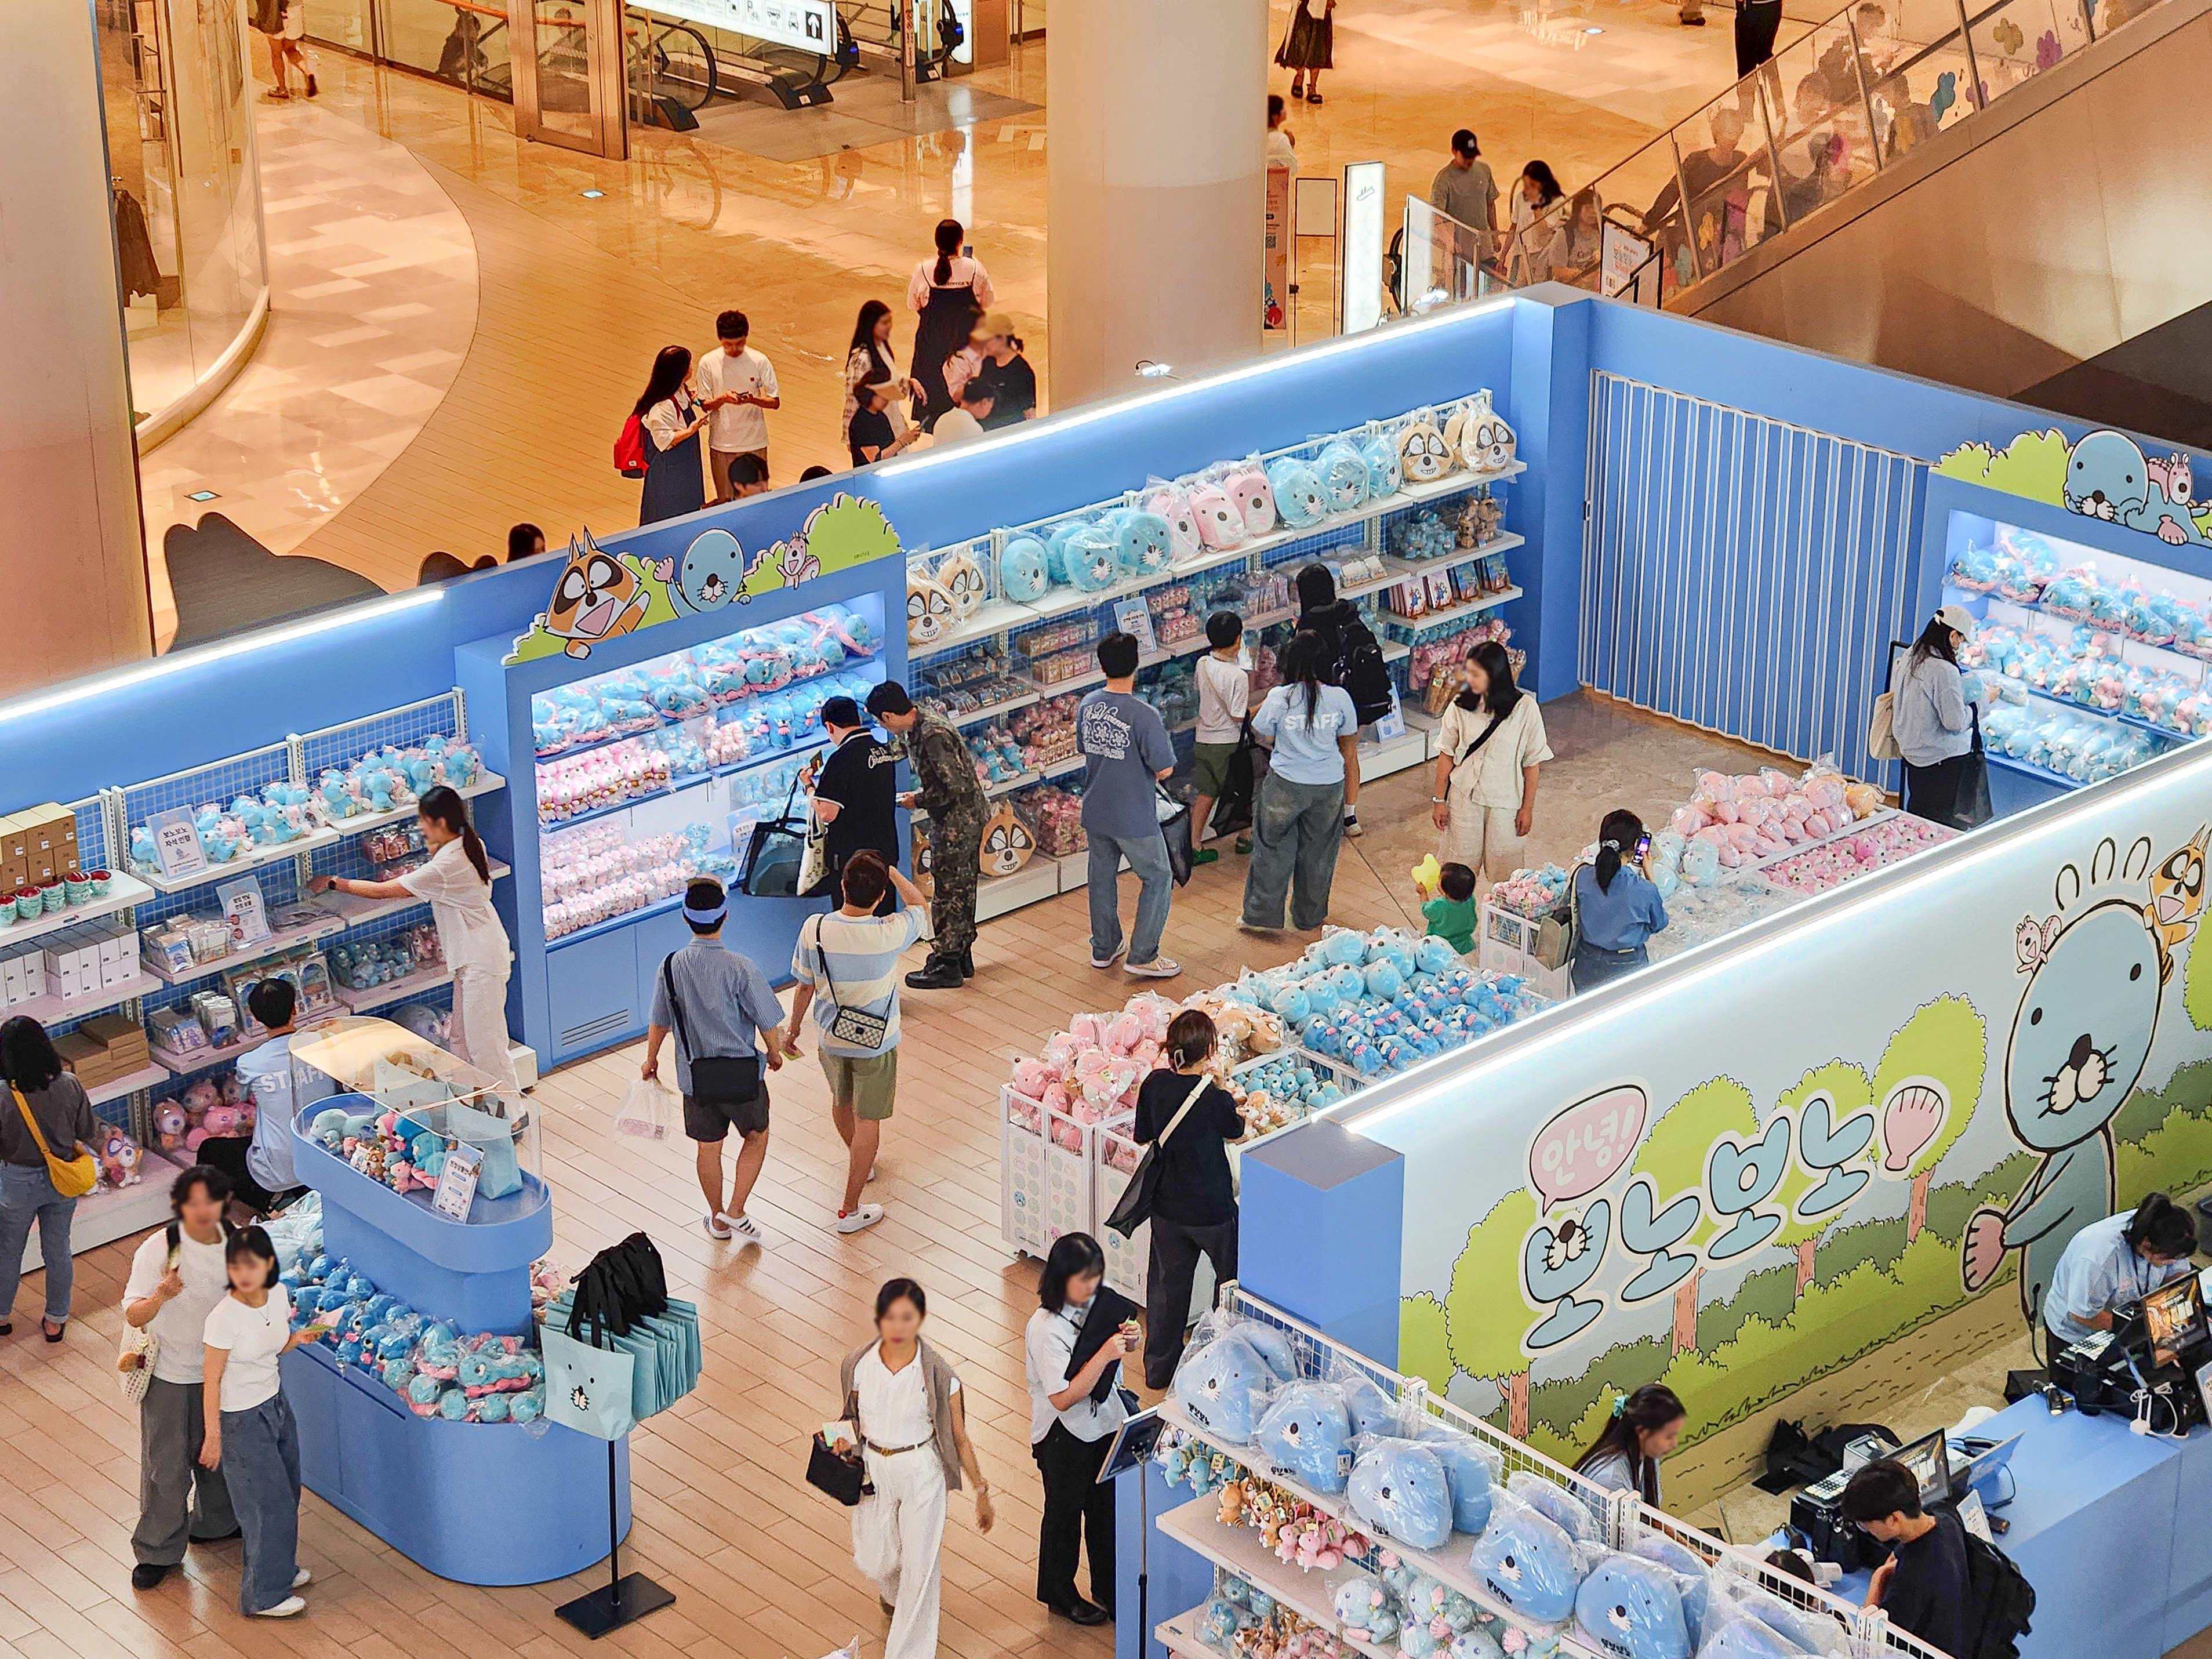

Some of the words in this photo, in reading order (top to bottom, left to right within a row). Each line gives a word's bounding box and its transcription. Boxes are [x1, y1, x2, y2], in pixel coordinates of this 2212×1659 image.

[163, 827, 188, 838] 보노보노
[165, 838, 178, 847] 자석
[1541, 1105, 1636, 1186] 안녕!
[1525, 1097, 1875, 1349] 보노보노
